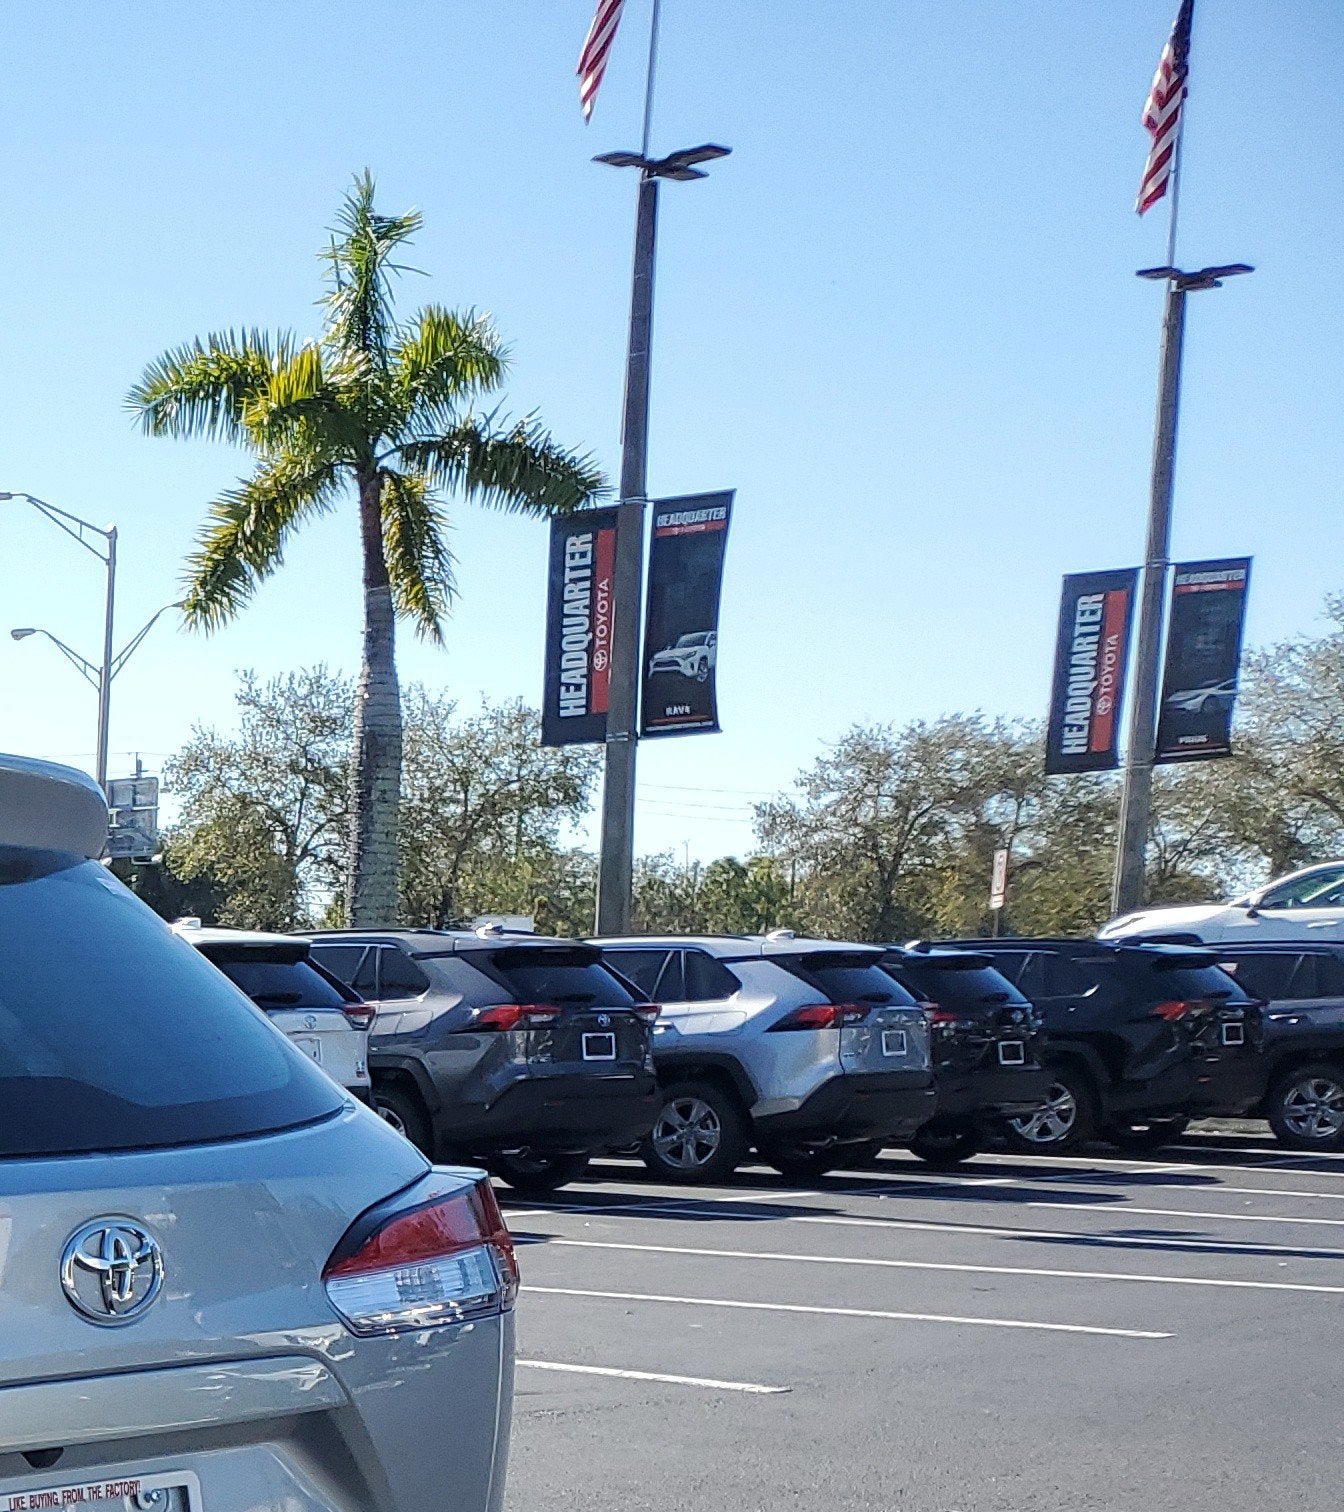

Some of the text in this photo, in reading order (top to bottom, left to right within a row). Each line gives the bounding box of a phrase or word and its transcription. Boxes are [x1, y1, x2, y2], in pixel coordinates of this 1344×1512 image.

[559, 532, 593, 717] HEADQUARTER
[594, 577, 610, 646] TOYOTA
[1062, 593, 1105, 756] HEADQUARTER
[1100, 633, 1119, 696] TOYOTA
[8, 1496, 27, 1511] LIKE
[29, 1491, 60, 1509] BUYING
[87, 1485, 102, 1500] THE
